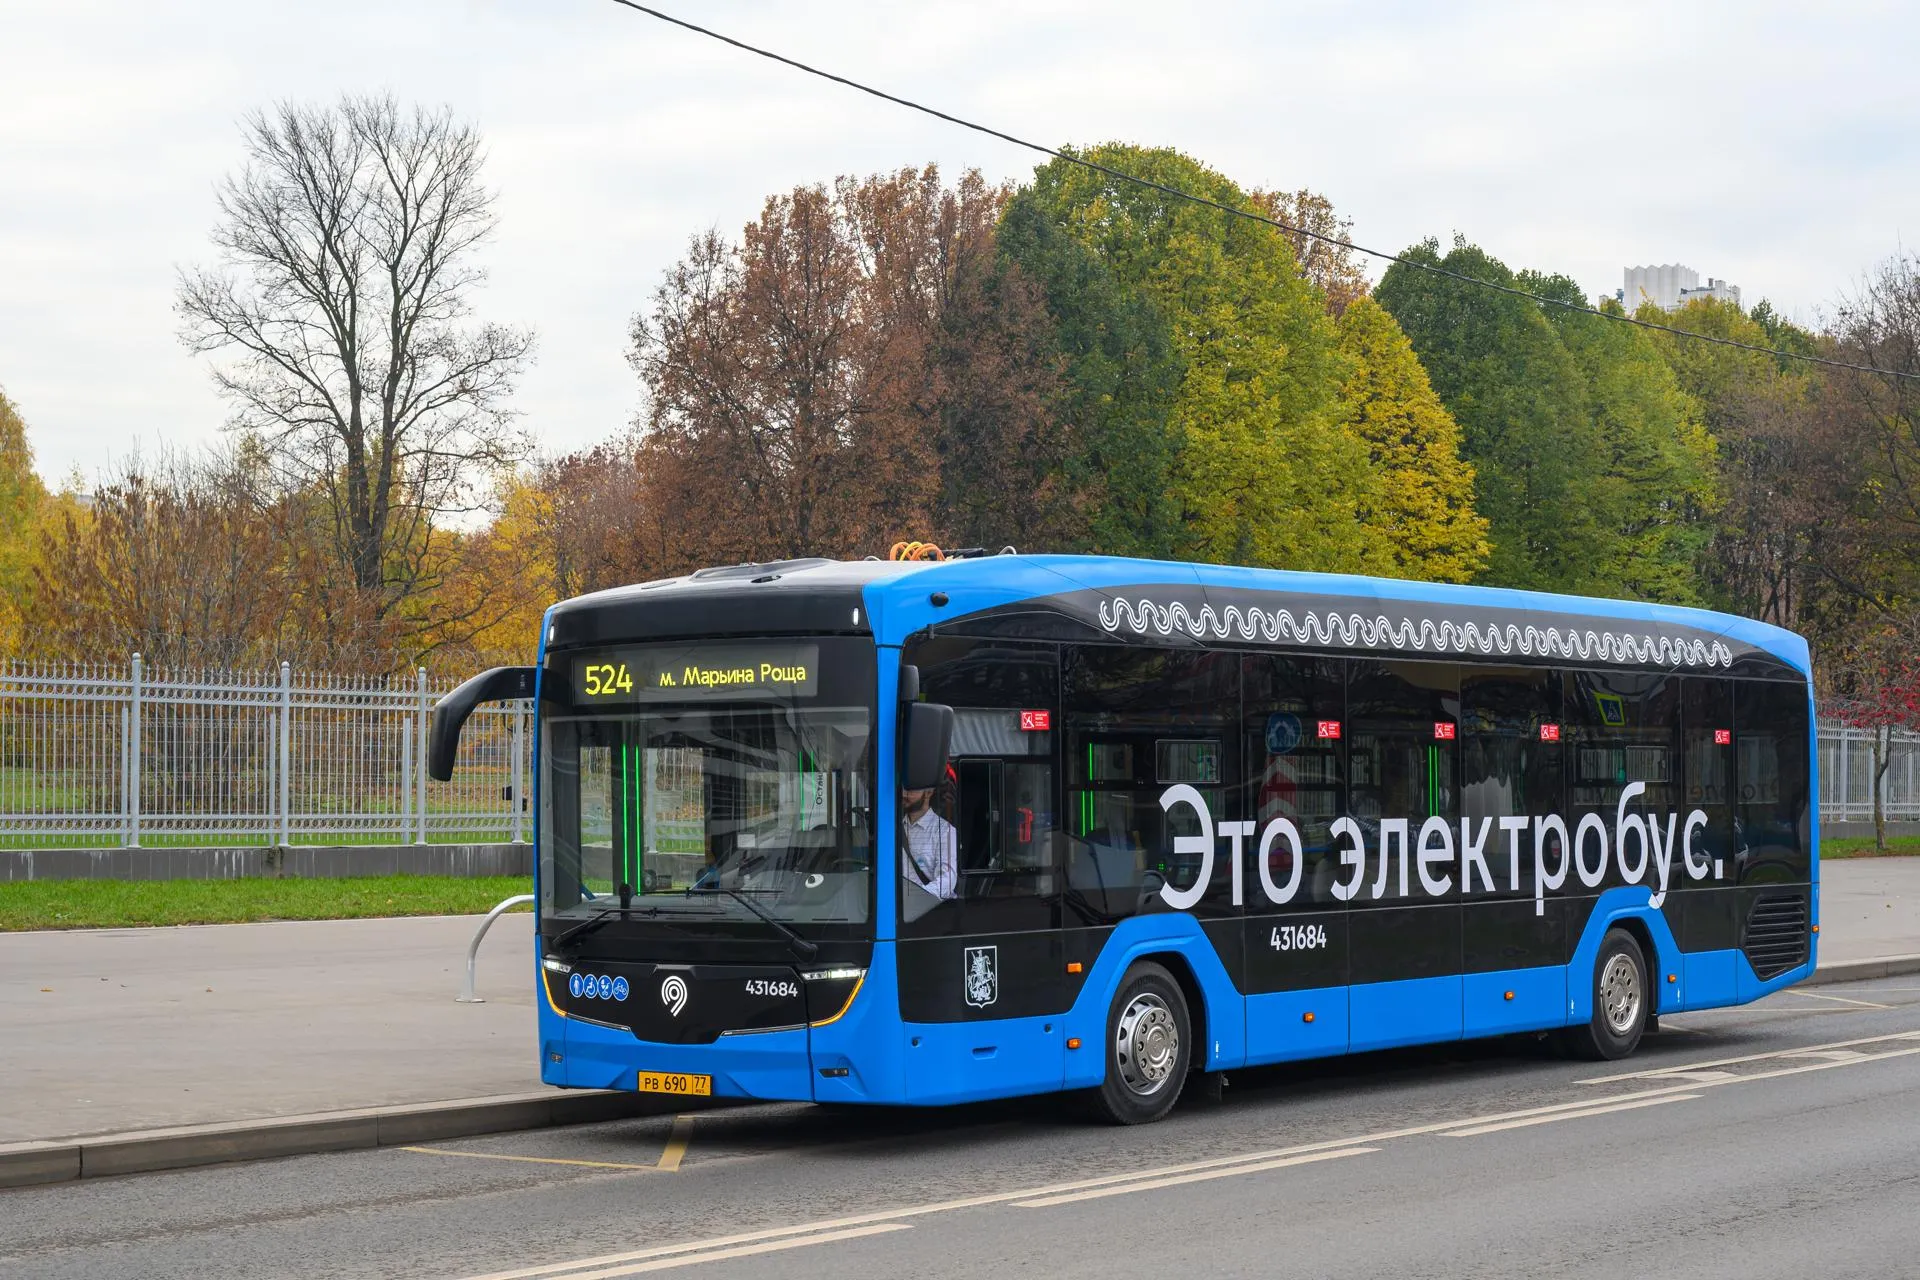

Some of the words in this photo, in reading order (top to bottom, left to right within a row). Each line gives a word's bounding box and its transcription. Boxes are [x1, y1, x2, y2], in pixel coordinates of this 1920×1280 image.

[585, 664, 633, 696] 524
[659, 672, 676, 687] м.
[682, 666, 755, 688] Марьина
[760, 663, 807, 684] Роща
[1159, 784, 1303, 909] Это
[1329, 781, 1724, 917] электробус.
[1270, 924, 1327, 950] 431684
[745, 979, 798, 997] 431684
[664, 1075, 687, 1092] 690
[693, 1076, 706, 1089] 77
